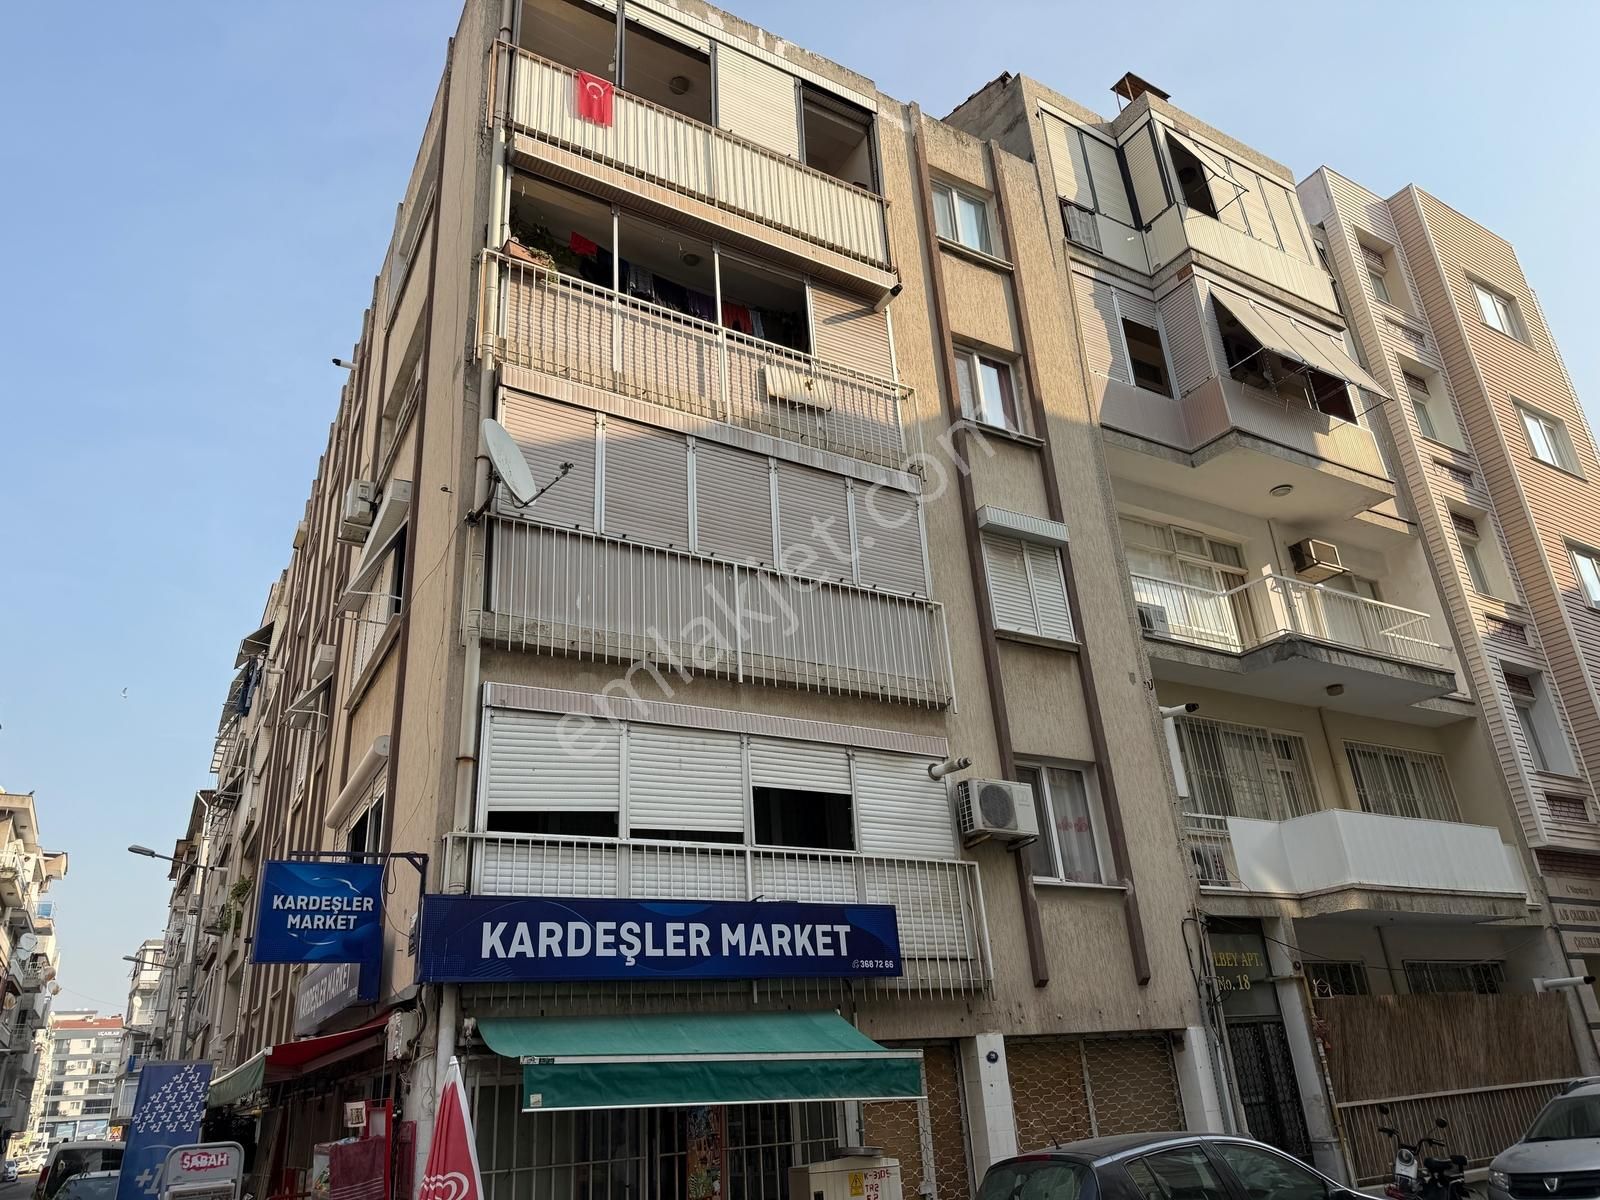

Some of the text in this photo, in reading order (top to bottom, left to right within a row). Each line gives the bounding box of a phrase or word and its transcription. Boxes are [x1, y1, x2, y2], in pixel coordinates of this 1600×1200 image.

[272, 895, 374, 914] KARDEŞLER
[287, 914, 357, 930] MARKET
[481, 921, 851, 967] KARDEŞLER MARKET
[860, 960, 894, 968] 368 72 66
[1241, 952, 1263, 967] APT.
[1236, 974, 1251, 991] 18
[184, 1064, 195, 1073] +1
[173, 1073, 200, 1083] +1 +1
[161, 1082, 204, 1092] +1 +1 +1
[150, 1093, 162, 1102] +1
[166, 1092, 178, 1102] +1
[182, 1092, 194, 1102] +1
[142, 1102, 199, 1113] +1 +1 +1 +1
[133, 1112, 204, 1123] +1 +1 +1 +1 +1
[137, 1122, 194, 1133] +1 +1 +1 +1
[182, 1152, 228, 1169] SABAH
[135, 1163, 164, 1194] +1
